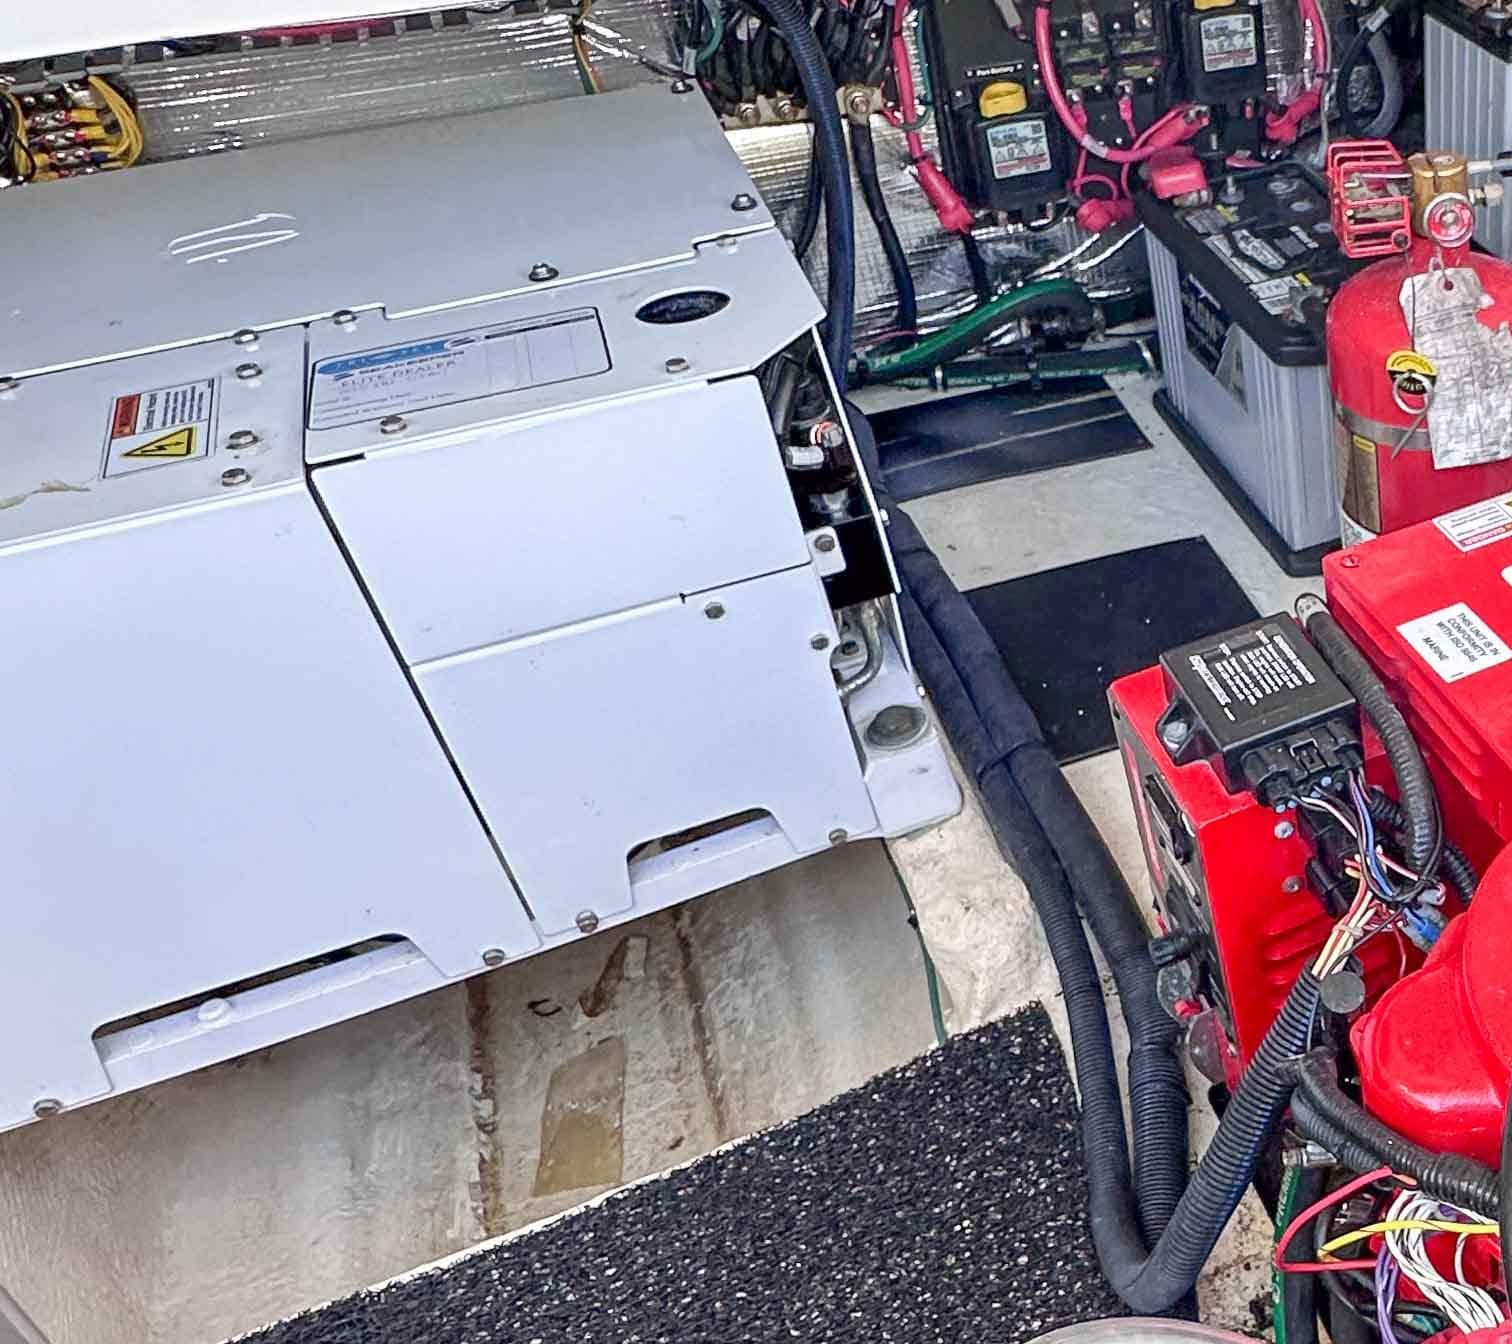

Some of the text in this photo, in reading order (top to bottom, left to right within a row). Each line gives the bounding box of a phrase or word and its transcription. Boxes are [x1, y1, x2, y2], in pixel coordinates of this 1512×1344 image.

[1436, 621, 1455, 638] WITH
[1450, 636, 1465, 649] ISO
[1448, 618, 1488, 657] CONFORMITY
[1457, 612, 1473, 627] THIS
[1470, 626, 1488, 641] UNIT
[1483, 640, 1494, 648] IS
